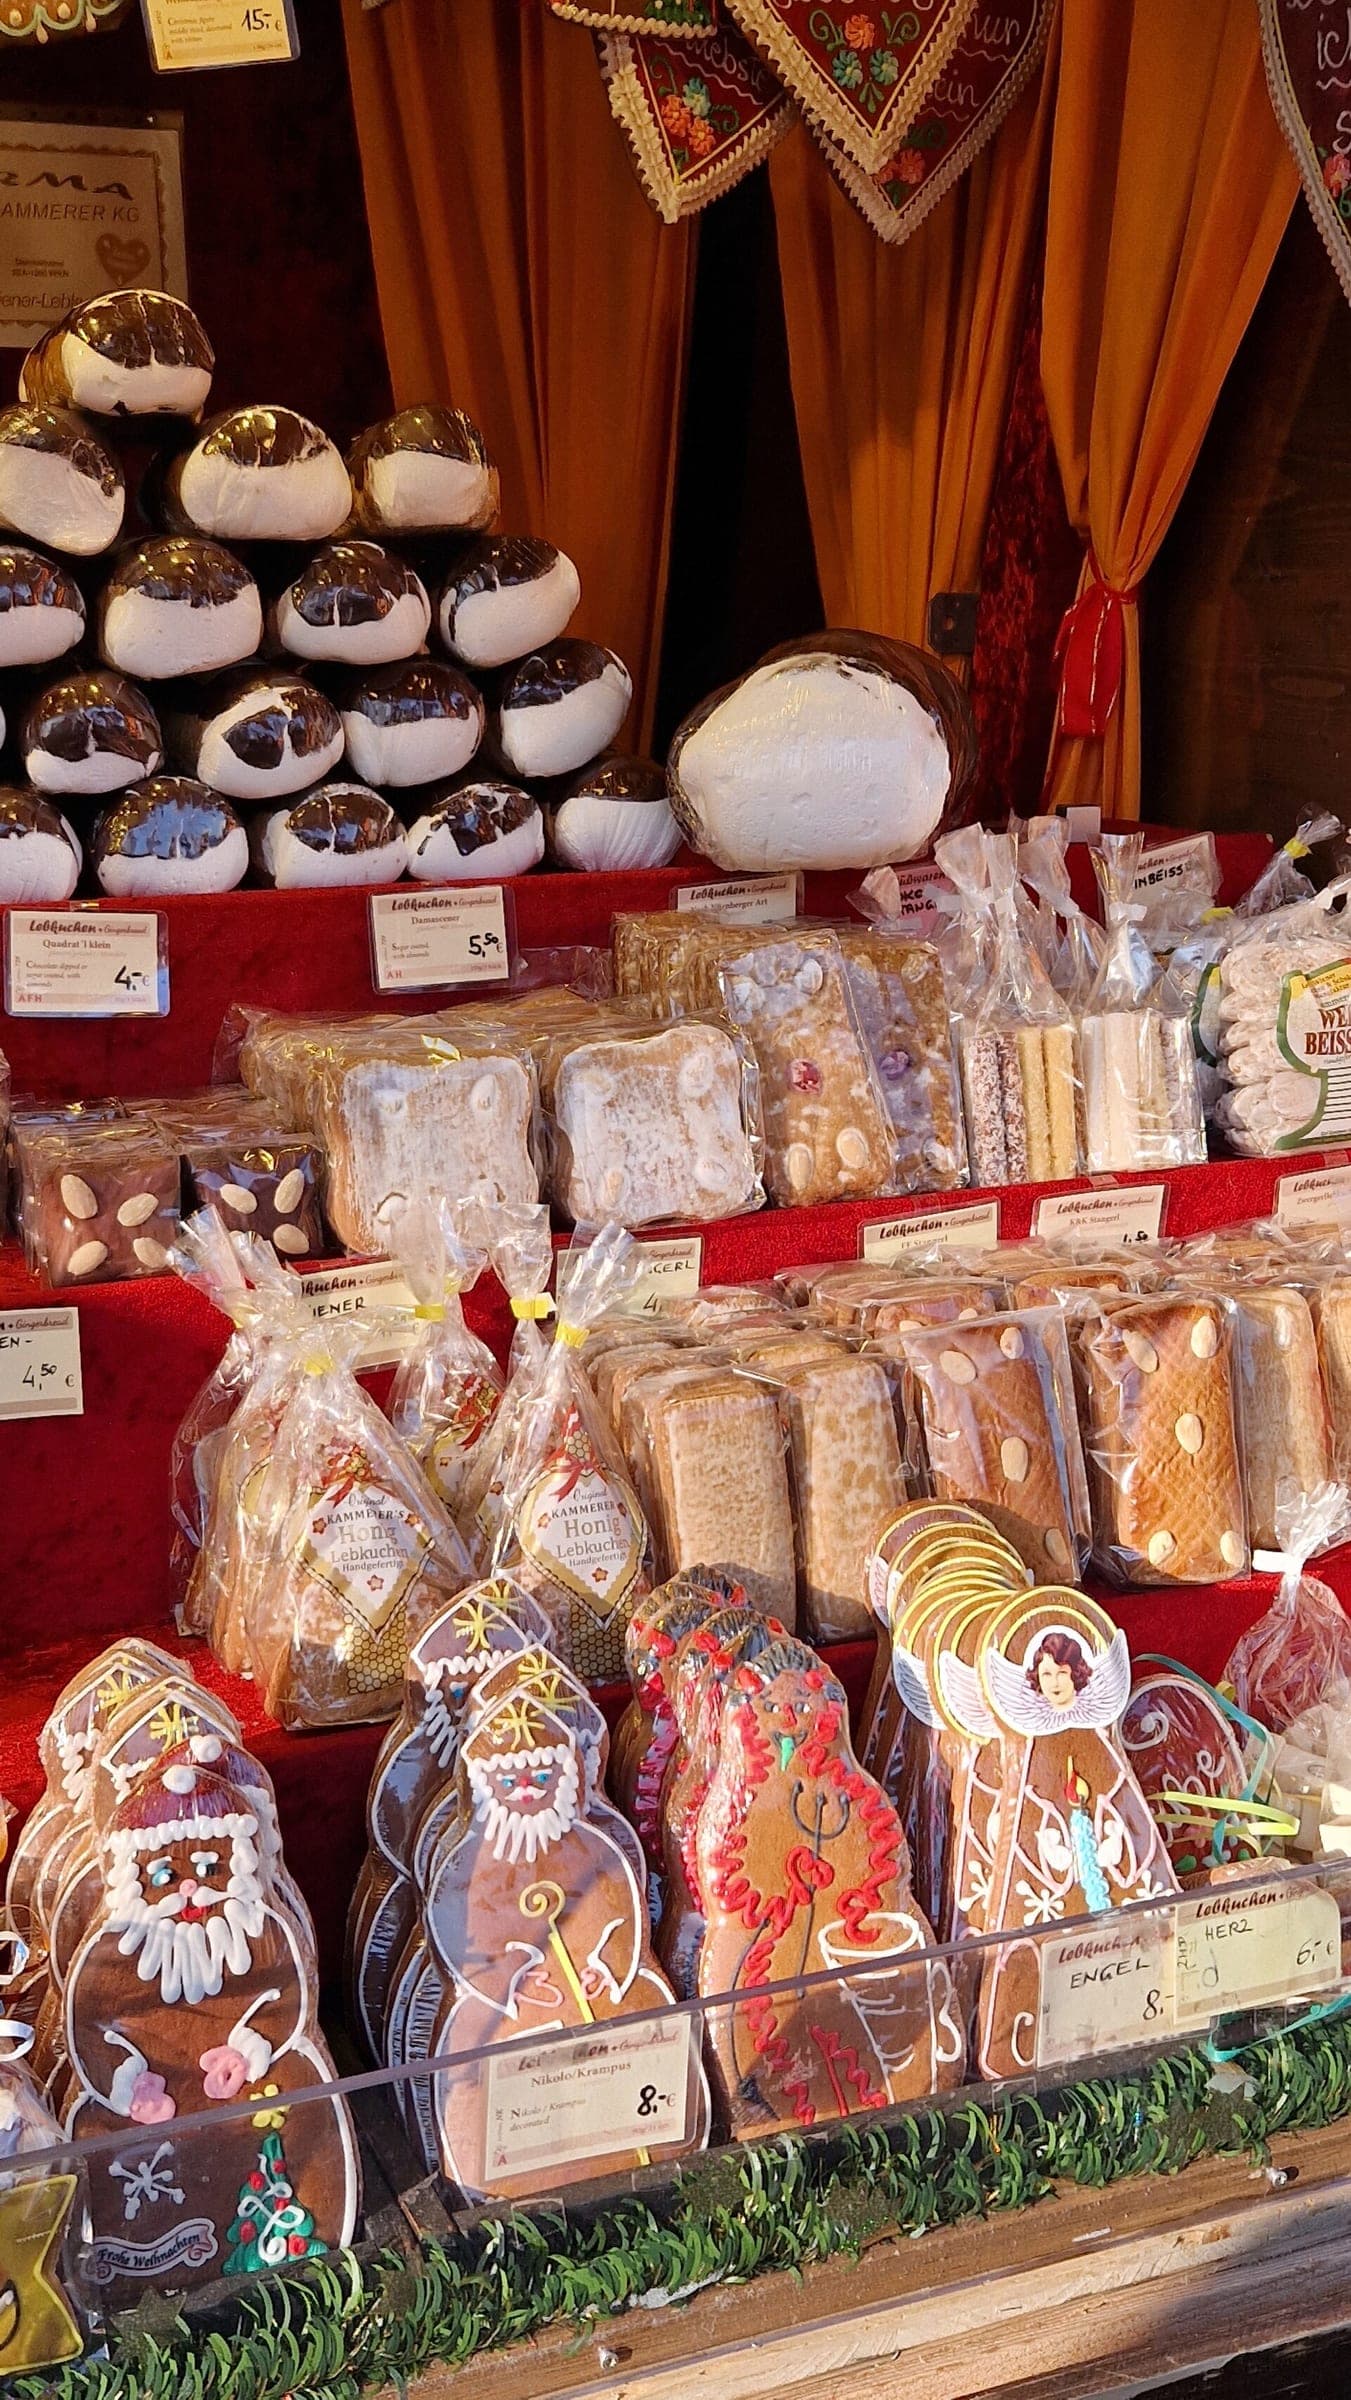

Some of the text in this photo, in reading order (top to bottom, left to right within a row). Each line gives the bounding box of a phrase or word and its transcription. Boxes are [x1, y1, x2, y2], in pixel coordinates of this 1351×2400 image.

[690, 886, 746, 900] Lebkuchen
[392, 897, 453, 911] Lebkuchen
[29, 919, 97, 935] Lebkuchen
[1057, 1199, 1113, 1214] Lebkuchen
[879, 1219, 942, 1239] Lebkuchen
[564, 1513, 622, 1539] Honig
[1196, 1891, 1277, 1919] Lebkuchen
[1070, 1958, 1150, 1989] ENGEL
[98, 2233, 201, 2267] Frohe Weihnachten
